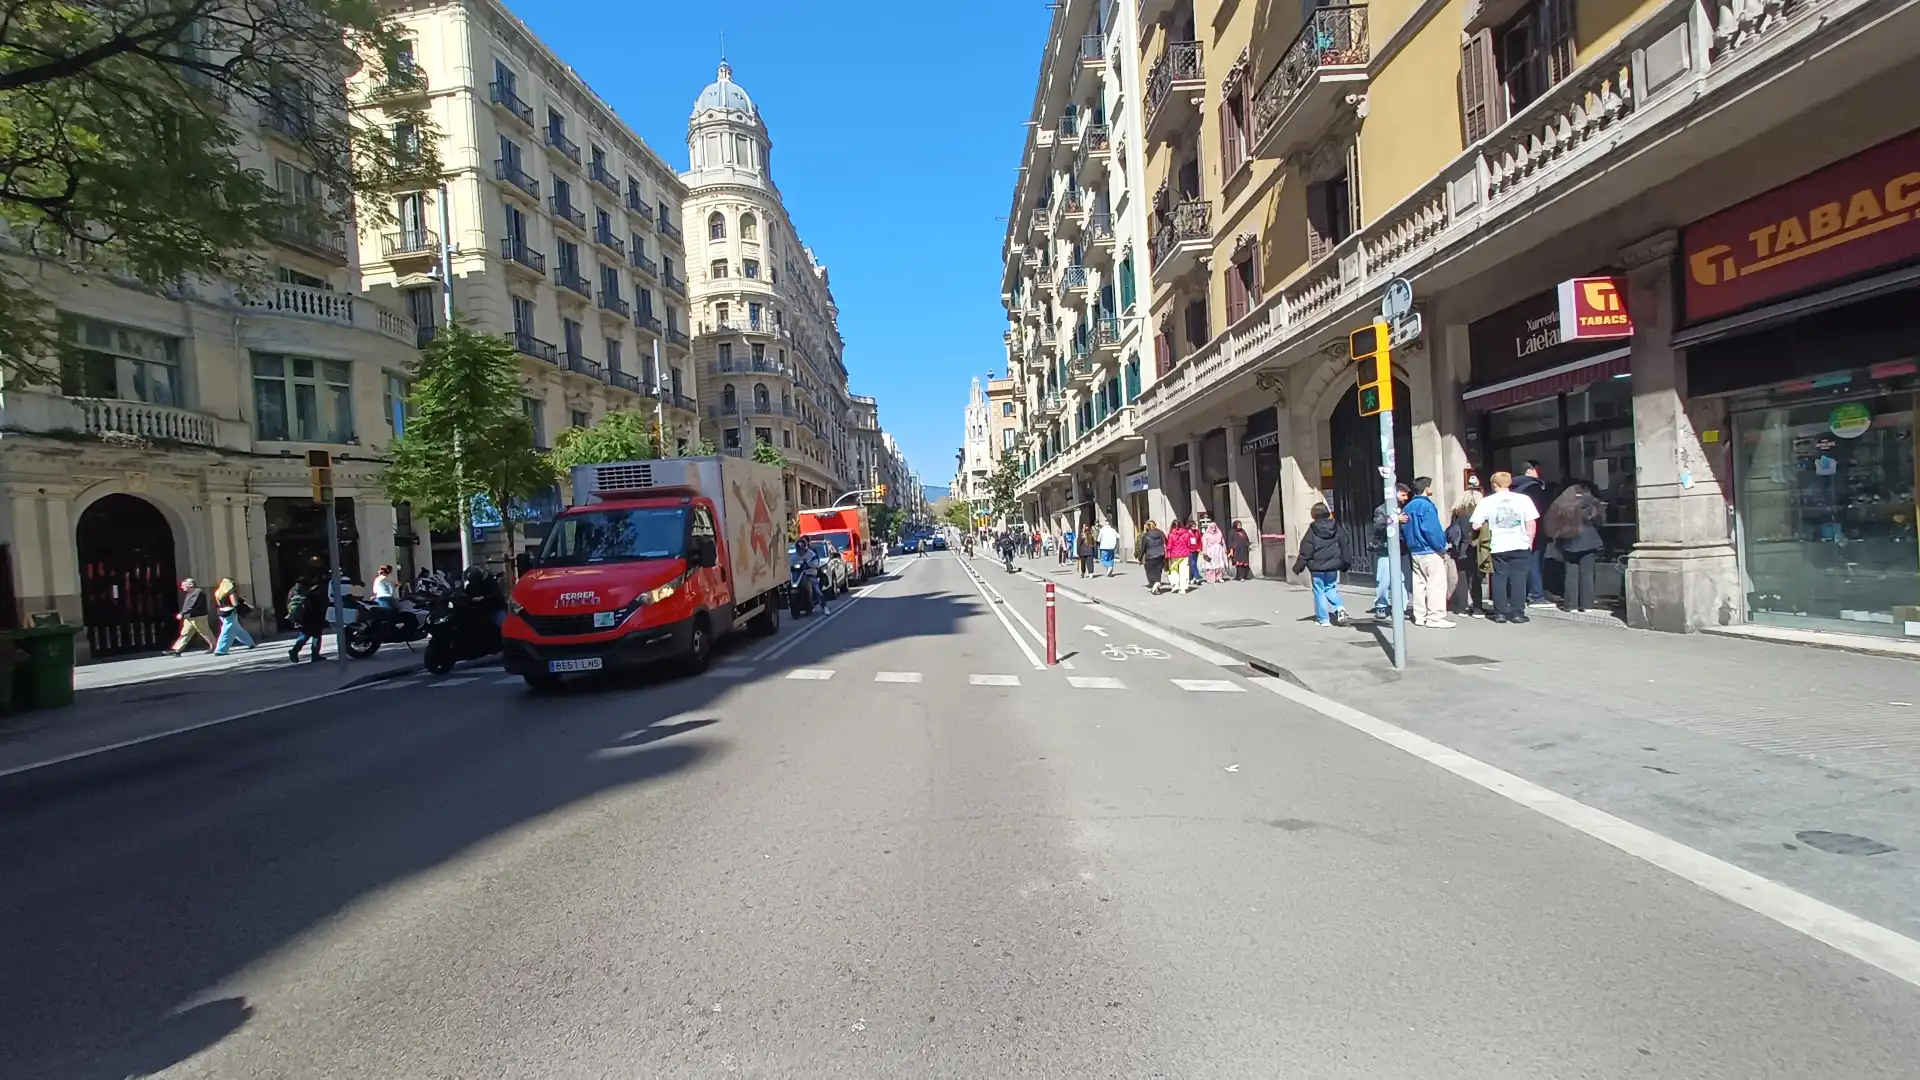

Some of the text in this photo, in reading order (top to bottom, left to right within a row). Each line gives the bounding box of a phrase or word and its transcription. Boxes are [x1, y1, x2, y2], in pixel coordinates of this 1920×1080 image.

[1749, 172, 1920, 258] TABAC
[1580, 314, 1627, 326] TABACS
[560, 591, 595, 600] FERRER
